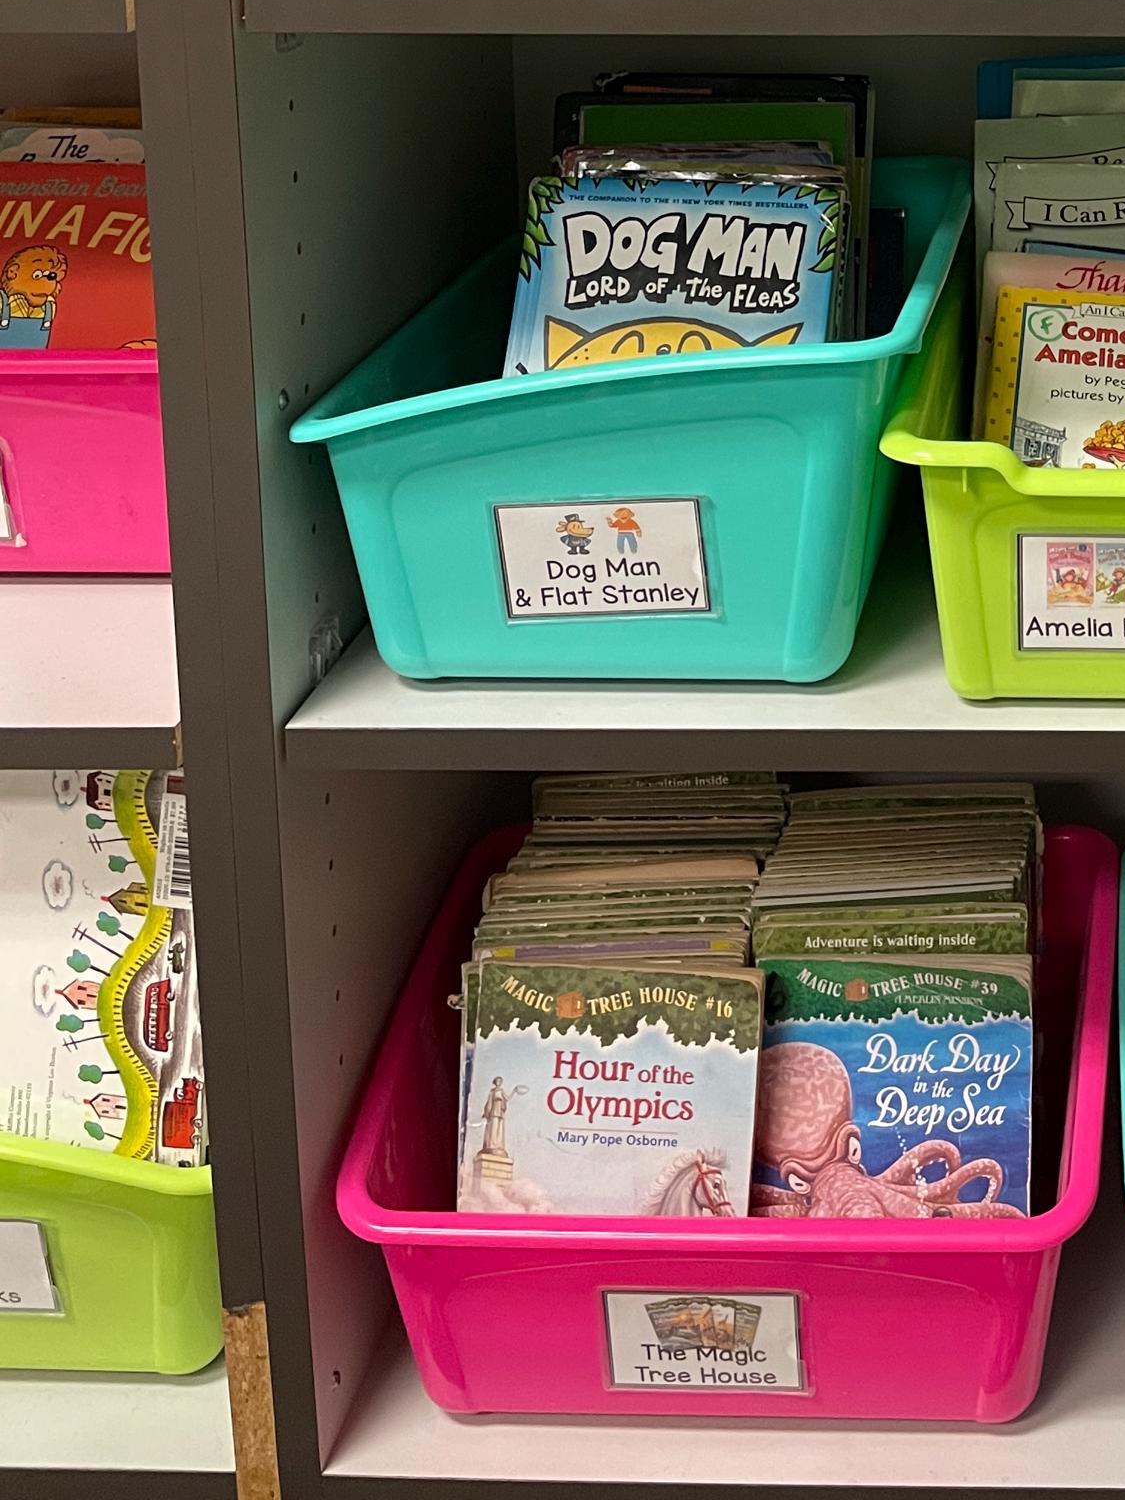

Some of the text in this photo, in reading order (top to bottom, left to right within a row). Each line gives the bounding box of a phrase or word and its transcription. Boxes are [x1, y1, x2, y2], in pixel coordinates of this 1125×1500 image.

[48, 134, 90, 159] The
[588, 195, 637, 203] COMPANION
[45, 204, 86, 245] A
[1044, 203, 1053, 222] I
[1059, 204, 1106, 224] Can
[566, 213, 804, 281] DOG MAN
[568, 276, 631, 304] LORD
[1084, 305, 1102, 316] An
[1084, 374, 1101, 387] by
[1050, 387, 1104, 402] pictures
[1108, 392, 1125, 405] by
[546, 557, 661, 583] Dog Man
[515, 582, 699, 608] & Flat Stanley
[1026, 616, 1113, 638] Amelia
[804, 934, 976, 949] Adventure is waiting inside
[796, 967, 999, 998] MAGIC TREE HOUSE #39
[500, 975, 733, 1019] MAGIC TREE HOUSE #16
[552, 1050, 695, 1086] Hour of the
[857, 1032, 1021, 1091] Dark Day
[913, 1076, 954, 1098] in the
[546, 1086, 695, 1126] Olympics
[866, 1082, 1007, 1136] Deep Sea
[557, 1131, 678, 1148] Mary Pope Osborne
[640, 1343, 767, 1366] The Magic
[634, 1366, 777, 1385] Tree House
